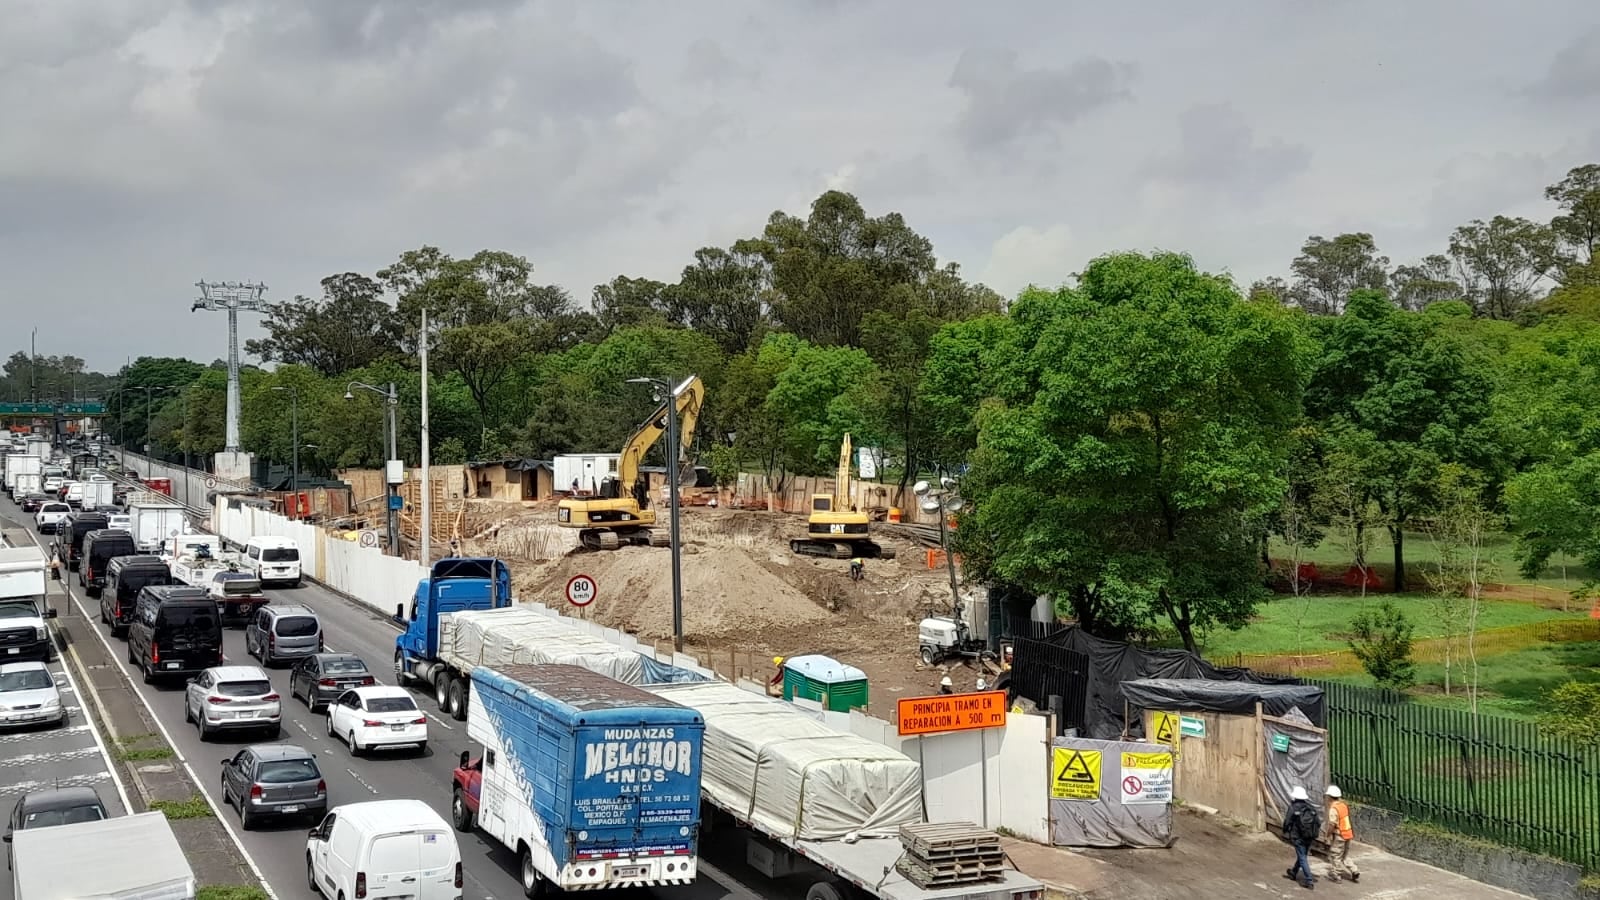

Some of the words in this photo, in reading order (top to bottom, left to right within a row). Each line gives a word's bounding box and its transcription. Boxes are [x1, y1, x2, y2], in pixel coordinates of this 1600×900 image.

[830, 524, 845, 534] CAT
[574, 581, 589, 592] 80
[913, 702, 951, 714] PRINCIPIA
[954, 699, 980, 711] TRAMO
[983, 698, 992, 709] EN
[903, 715, 952, 730] REPARACION
[955, 715, 961, 725] A
[969, 713, 983, 724] 500
[991, 713, 1001, 722] m
[604, 728, 675, 740] MUDANZAS
[584, 741, 691, 780] MELCHOR
[605, 768, 669, 783] HNOS.
[588, 818, 627, 826] EMPAQUES
[640, 814, 690, 823] ALMACENAJES
